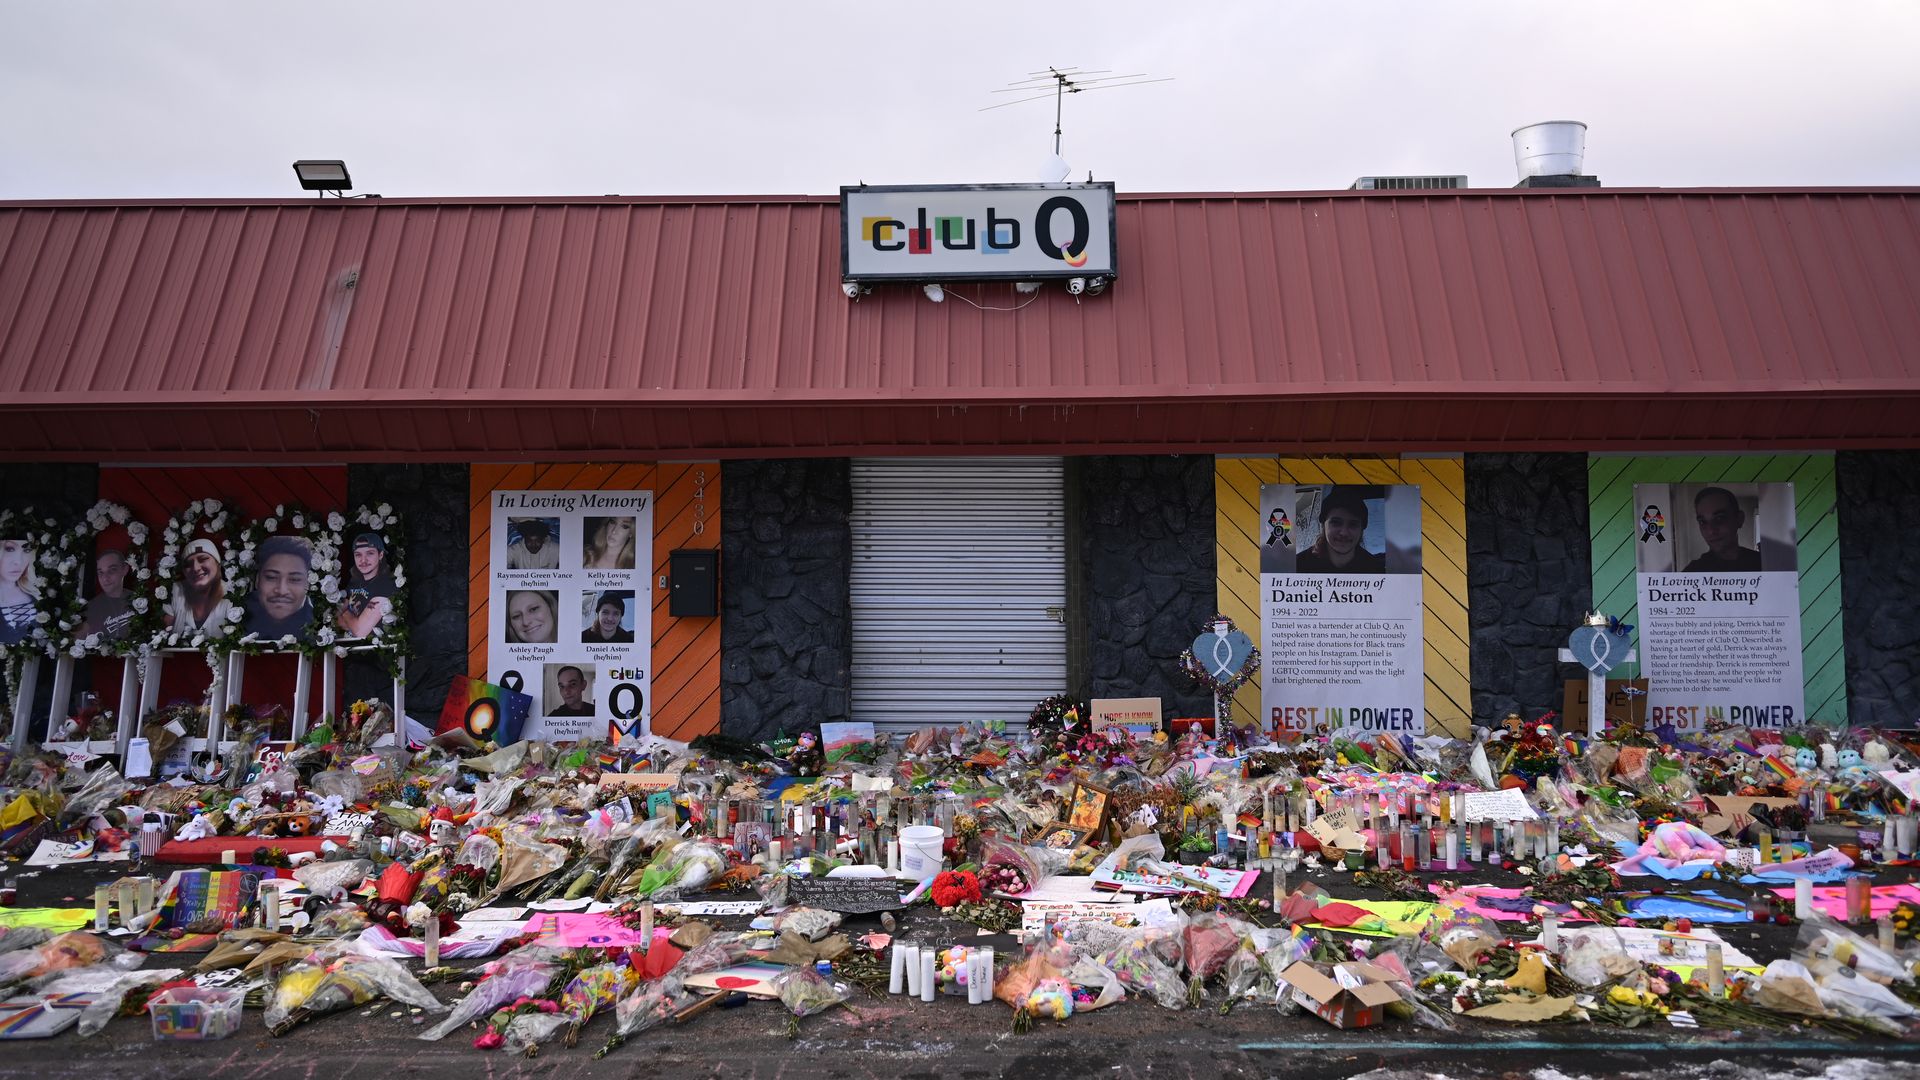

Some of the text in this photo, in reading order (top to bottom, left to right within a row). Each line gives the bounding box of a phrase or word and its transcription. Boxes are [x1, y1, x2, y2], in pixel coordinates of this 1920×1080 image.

[872, 196, 1089, 267] club Q
[499, 494, 646, 512] In Loving Memory
[498, 572, 528, 580] Raymond
[595, 578, 623, 587] (she/her)
[1272, 578, 1385, 590] In Loving Memory of
[1648, 576, 1761, 588] In Loving Memory of
[1272, 590, 1372, 603] Daniel Aston
[1649, 589, 1758, 605] Derrick Rump
[1272, 608, 1318, 616] 1994 2022
[1676, 607, 1695, 615] 2022
[1650, 621, 1673, 629] Always
[1676, 621, 1697, 629] bubbly
[1272, 631, 1309, 640] outspoken
[1360, 632, 1407, 640] continuously
[1650, 629, 1677, 637] shortage
[1272, 640, 1295, 649] helped
[1272, 650, 1296, 658] people
[1651, 645, 1673, 654] having
[1764, 645, 1787, 653] always
[1669, 651, 1678, 659] for
[1702, 651, 1729, 659] whether
[1751, 652, 1777, 660] through
[611, 667, 643, 680] club
[1301, 669, 1341, 677] community
[1389, 669, 1404, 677] light
[1744, 669, 1765, 678] people
[1288, 677, 1326, 685] brightened
[1754, 675, 1770, 683] liked
[609, 683, 643, 719] Q
[1578, 690, 1626, 706] LVE
[1272, 707, 1413, 730] REST IN POWER
[1653, 706, 1698, 728] REST
[1731, 706, 1793, 728] POWER
[572, 720, 592, 728] Rump
